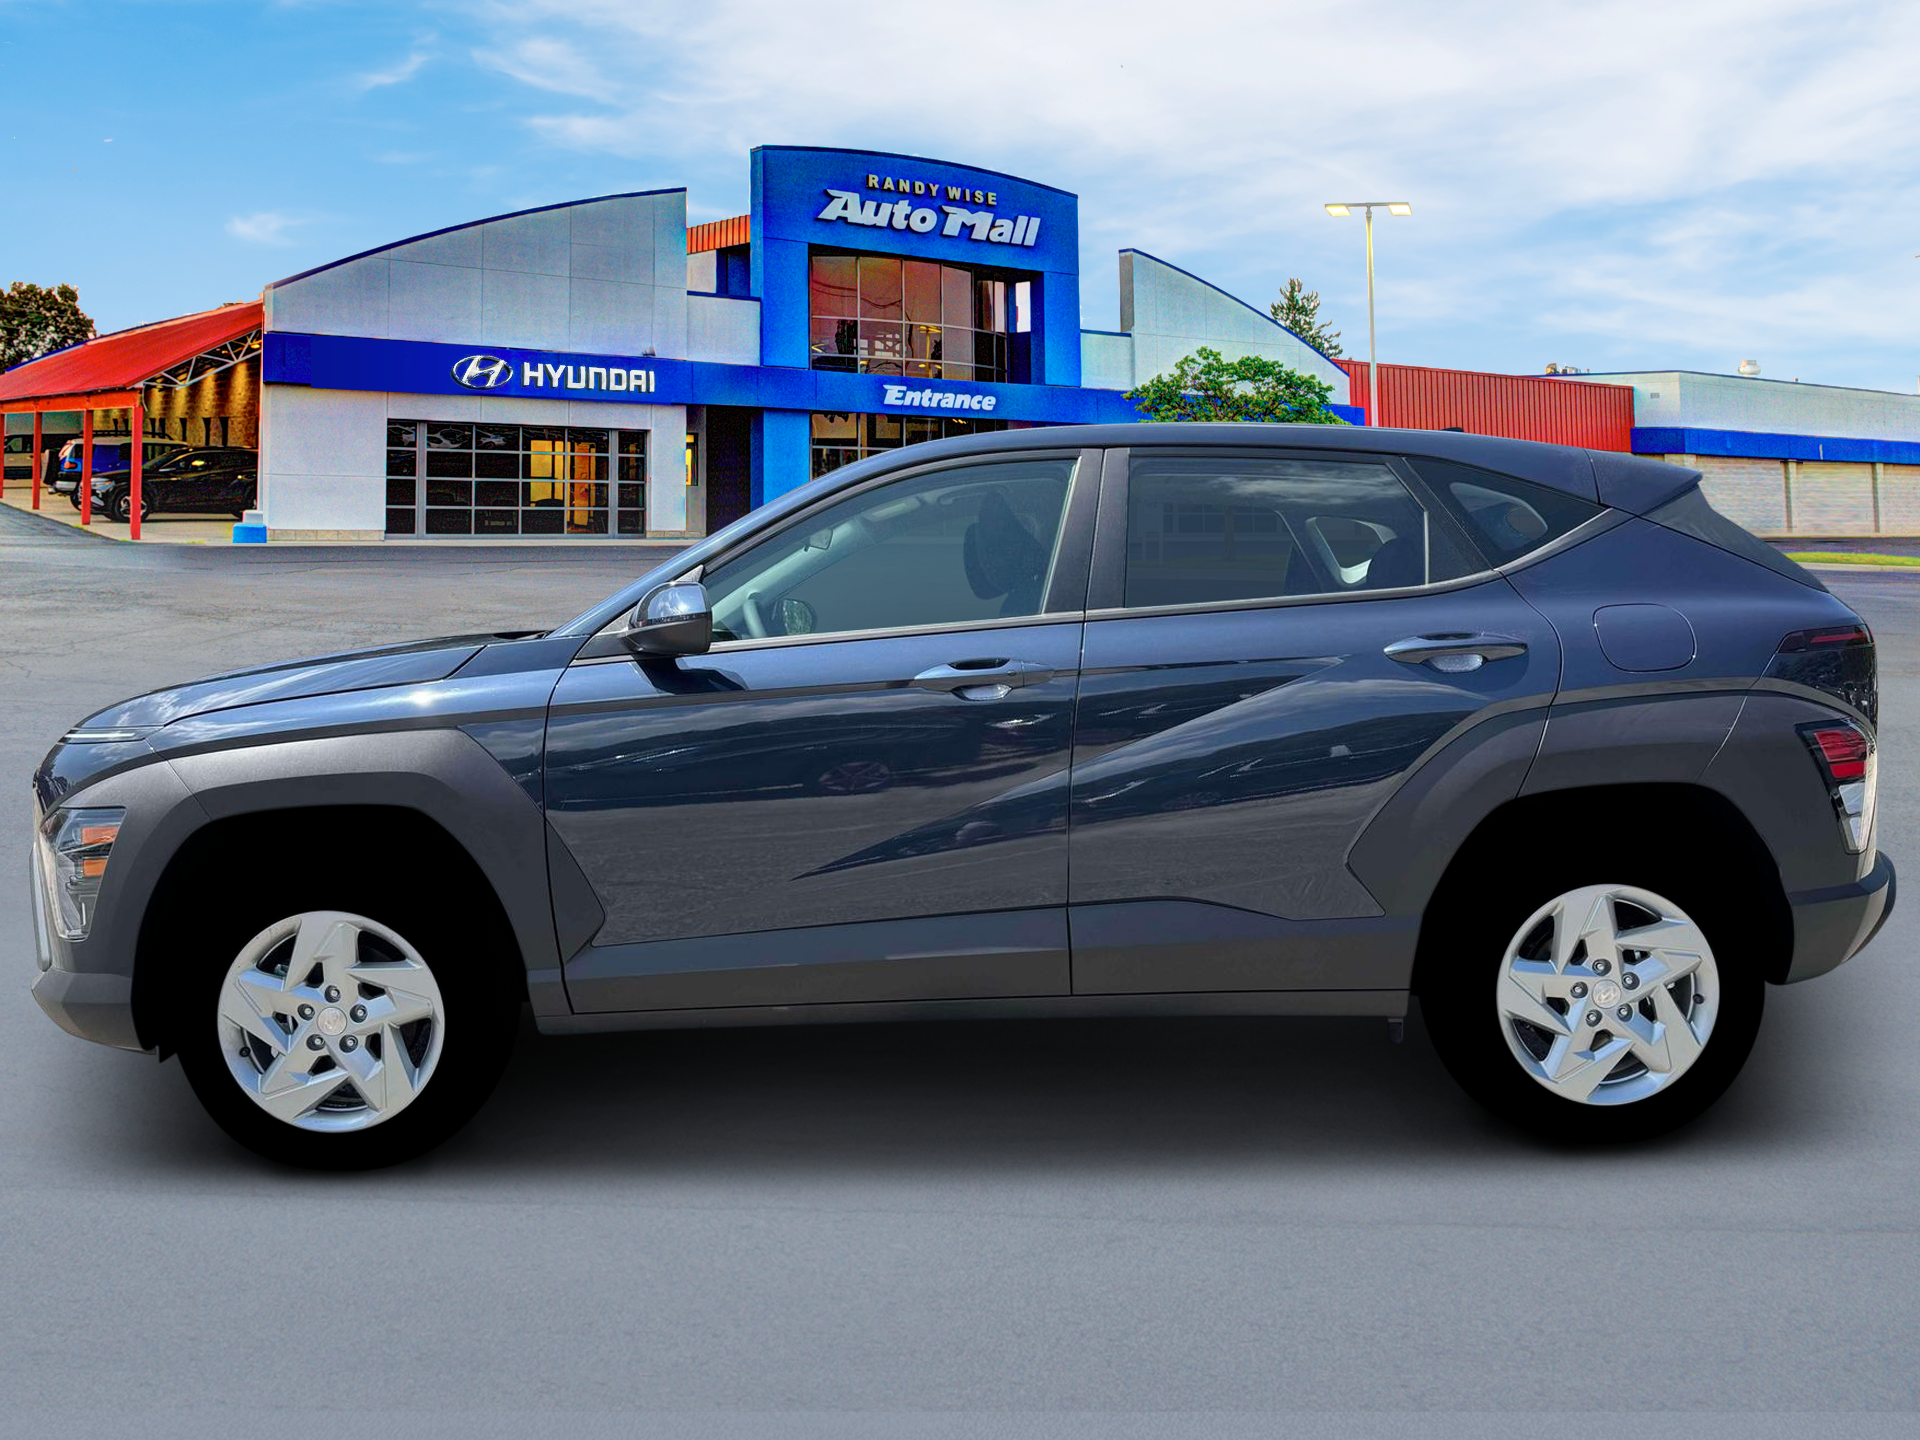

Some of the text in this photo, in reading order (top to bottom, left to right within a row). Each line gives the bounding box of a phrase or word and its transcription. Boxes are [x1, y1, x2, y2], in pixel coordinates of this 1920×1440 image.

[867, 174, 998, 205] RANDY WISE
[817, 189, 1041, 247] Auto Mall
[522, 362, 655, 393] HYUNDAI
[882, 384, 997, 411] Entrance
